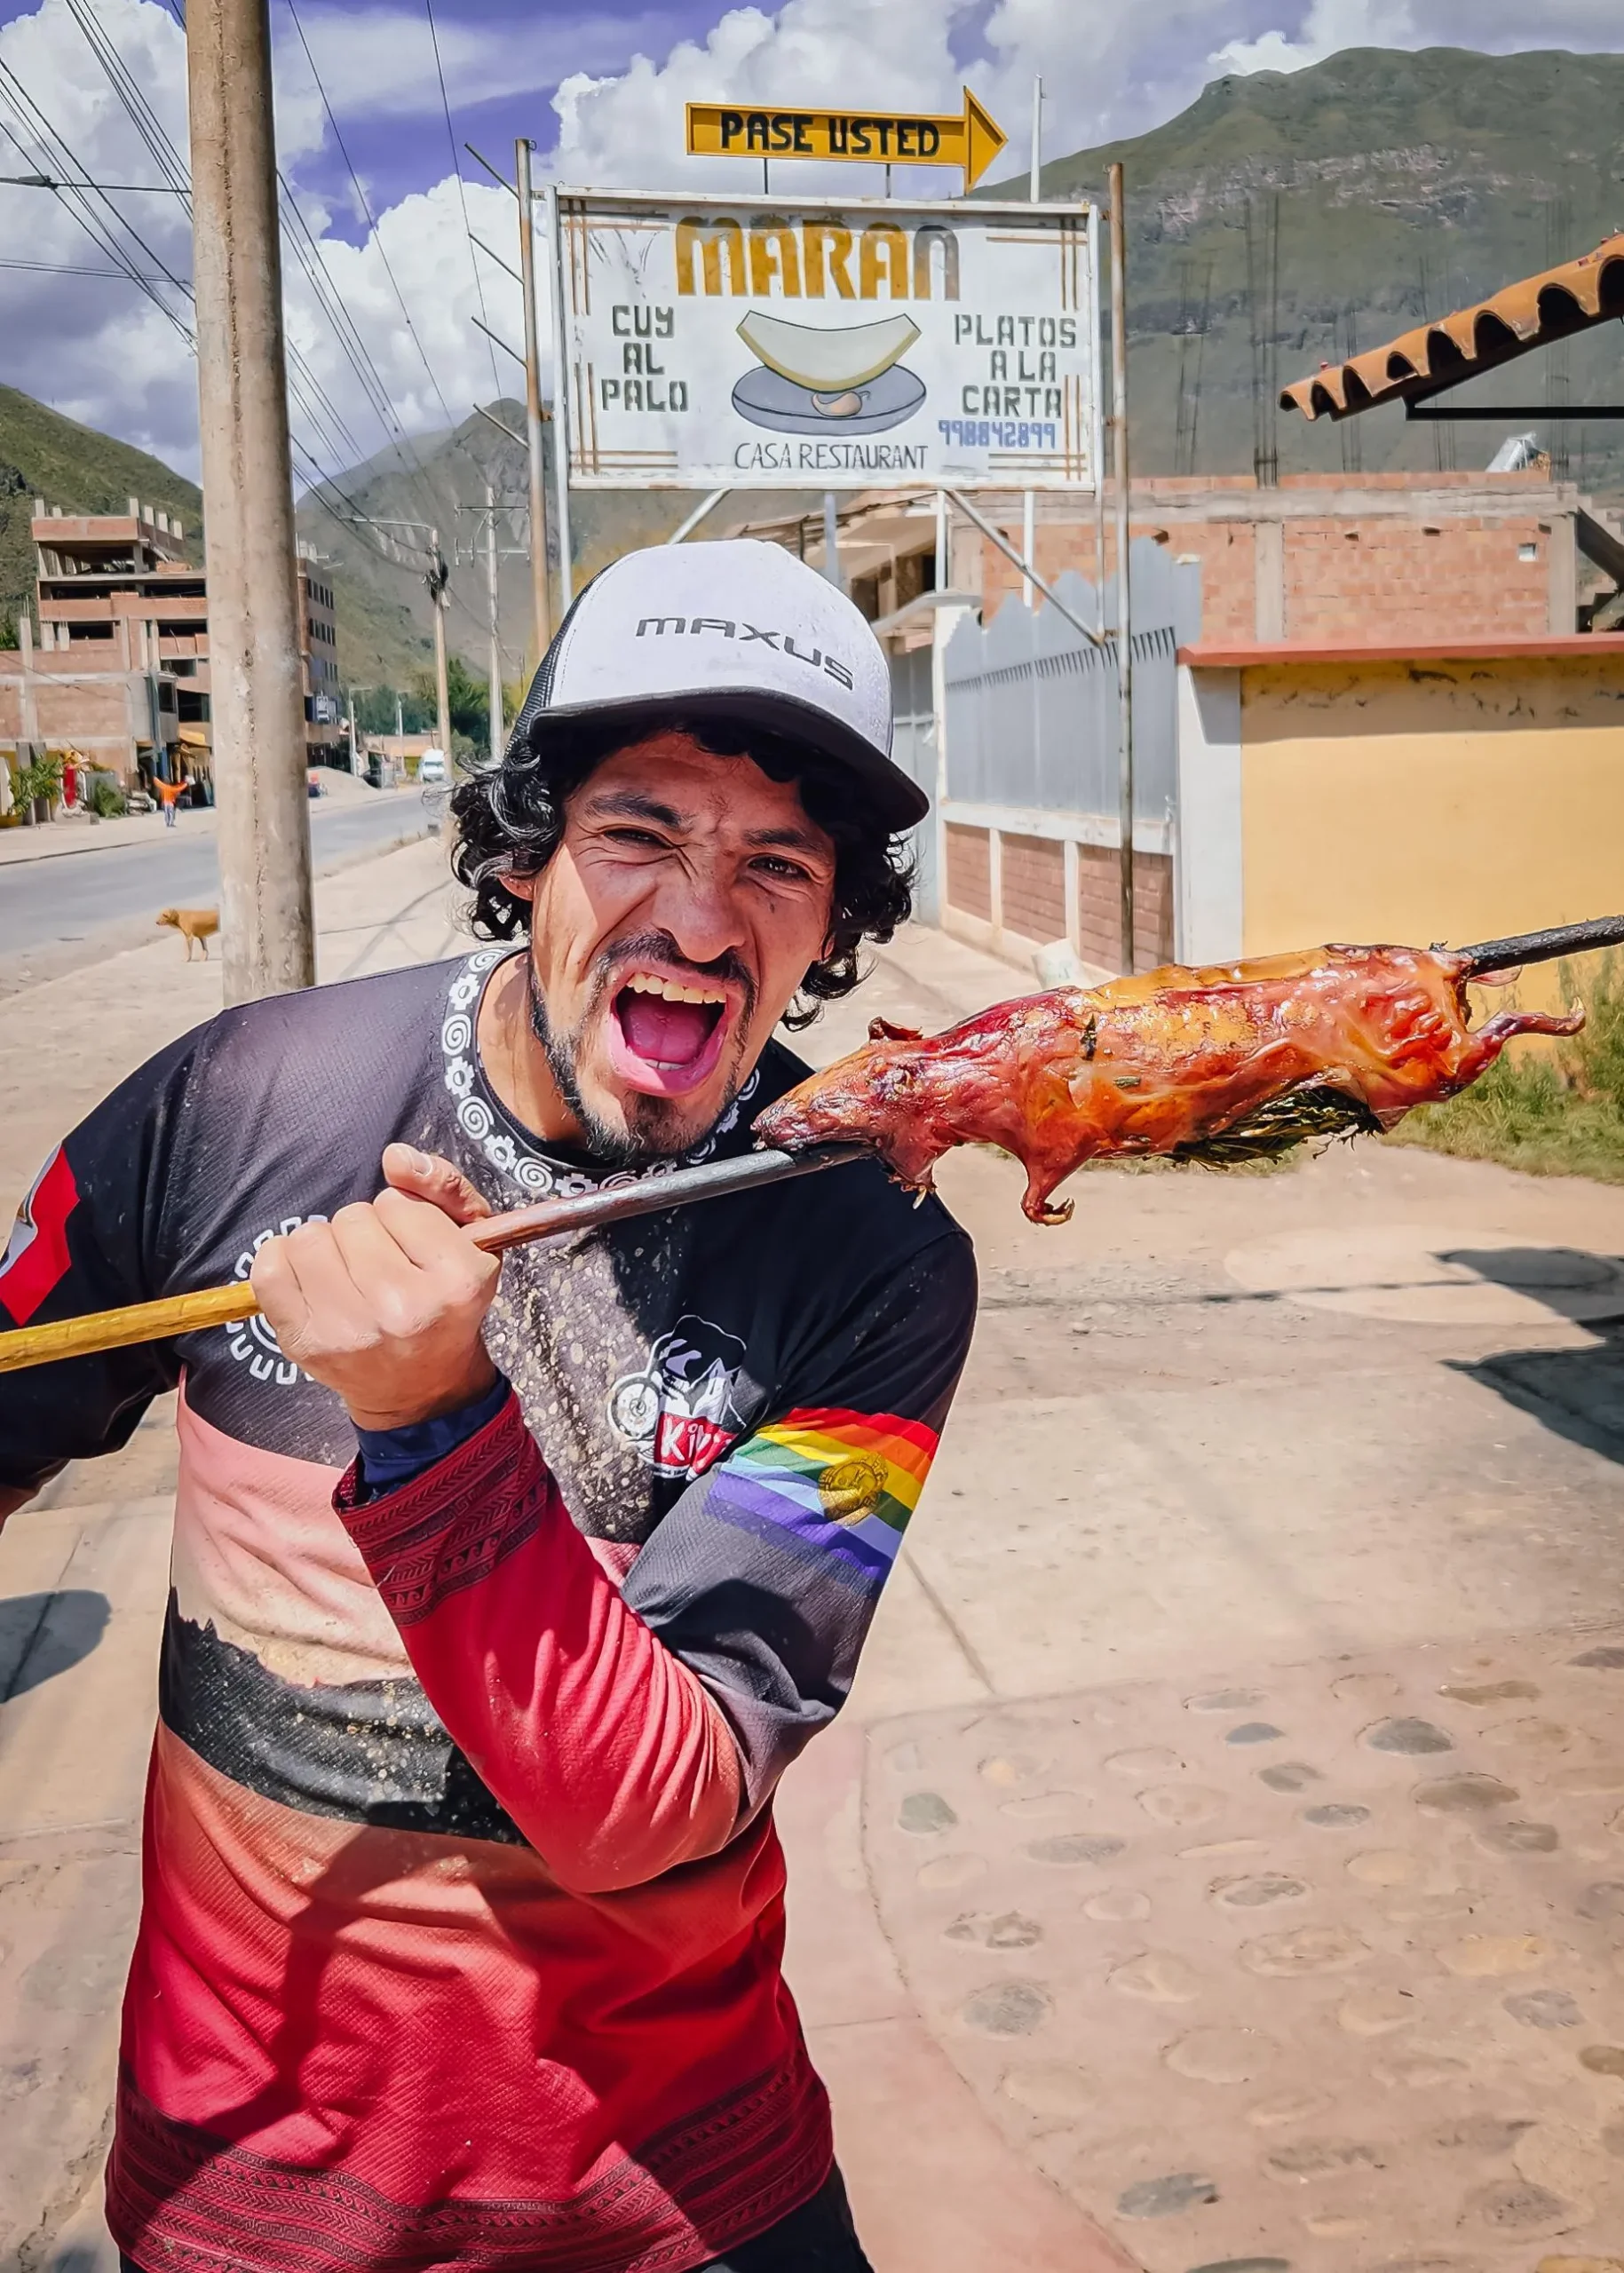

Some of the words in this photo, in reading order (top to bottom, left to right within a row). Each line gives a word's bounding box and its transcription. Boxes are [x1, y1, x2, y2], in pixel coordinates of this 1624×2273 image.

[721, 112, 813, 153] PASE
[828, 117, 939, 157] USTED
[676, 215, 961, 300] MARAN
[612, 305, 675, 338] CUY
[954, 313, 1077, 349] PLATOS
[623, 342, 665, 375] AL
[990, 350, 1008, 381] A
[1018, 350, 1057, 383] LA
[601, 379, 689, 412] PALO
[962, 384, 1062, 419] CARTA
[938, 419, 1056, 449] 998842899
[734, 442, 792, 470] CASA
[798, 443, 929, 471] RESTAURANT
[636, 617, 854, 691] MAXUS
